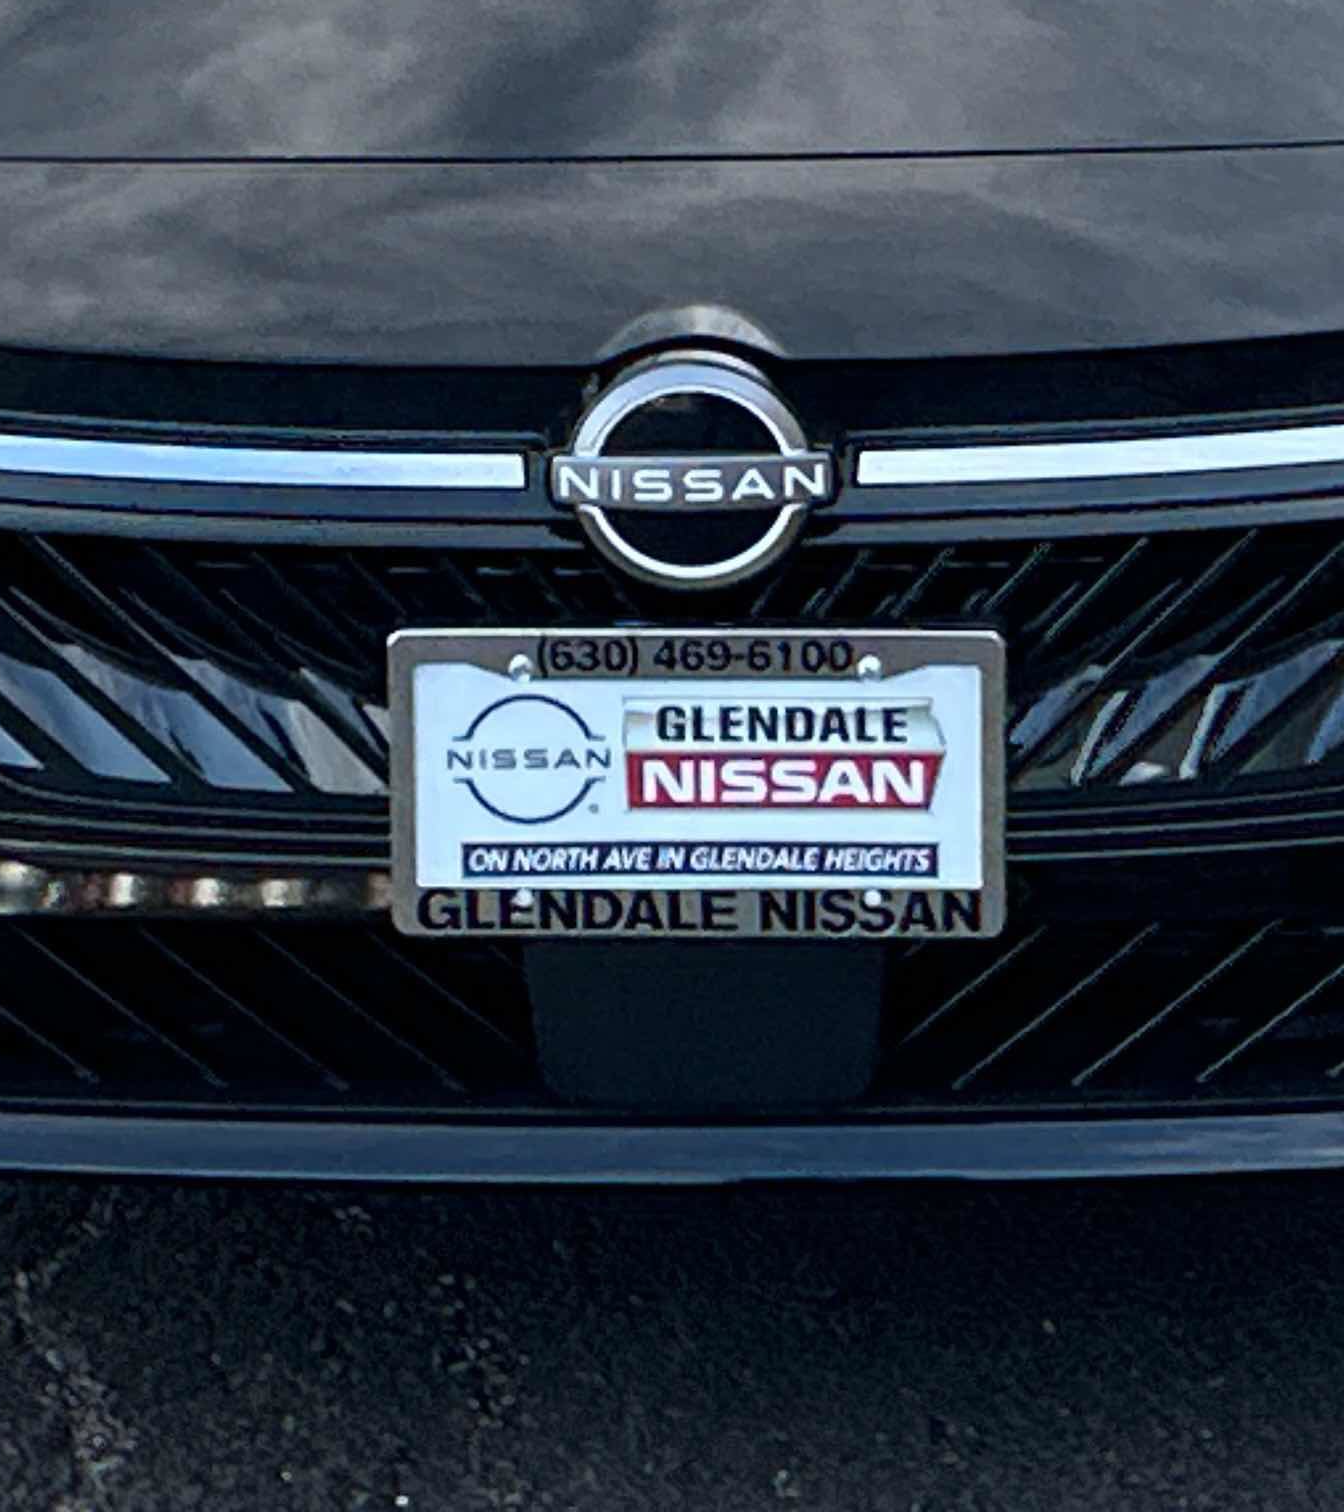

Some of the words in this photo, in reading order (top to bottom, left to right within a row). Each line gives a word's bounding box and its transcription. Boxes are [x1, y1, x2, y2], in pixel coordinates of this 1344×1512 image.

[559, 463, 824, 502] NISSAN
[537, 635, 638, 678] (630)
[654, 639, 854, 672] 469-6100
[656, 705, 908, 742] GLENDALE
[446, 748, 611, 770] NISSAN
[642, 758, 925, 803] NISSAN
[468, 847, 508, 872] ON
[512, 846, 599, 871] NORTH
[602, 846, 653, 871] AVE
[656, 846, 686, 871] IN
[689, 846, 818, 871] GLENDALE
[823, 847, 931, 872] HEIGHTS
[416, 888, 739, 932] GLENDALE
[760, 888, 981, 932] NISSAN
